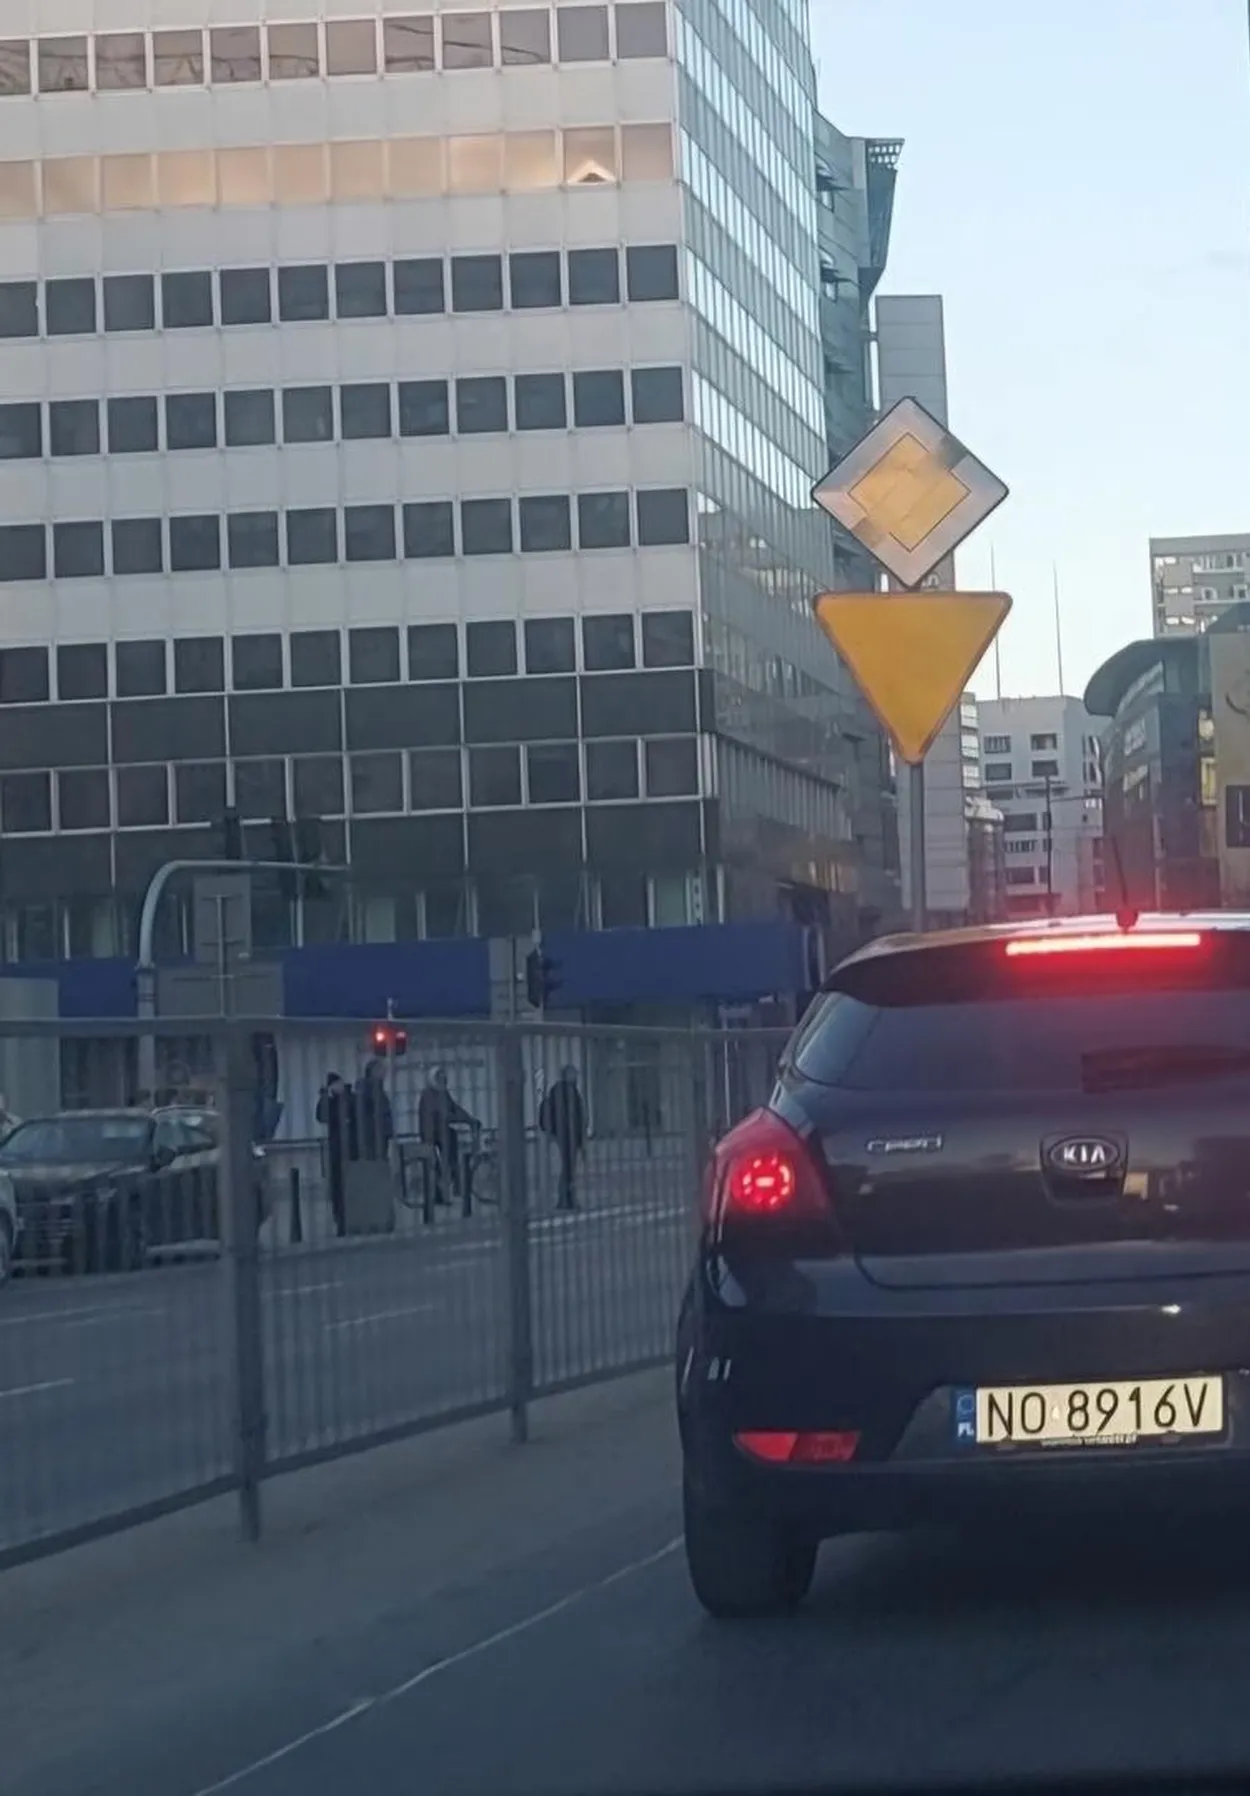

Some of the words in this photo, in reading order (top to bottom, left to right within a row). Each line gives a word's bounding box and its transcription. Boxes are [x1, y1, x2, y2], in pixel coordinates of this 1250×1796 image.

[1062, 1144, 1107, 1163] KIA
[987, 1391, 1047, 1437] NO
[1067, 1382, 1209, 1433] 8916V
